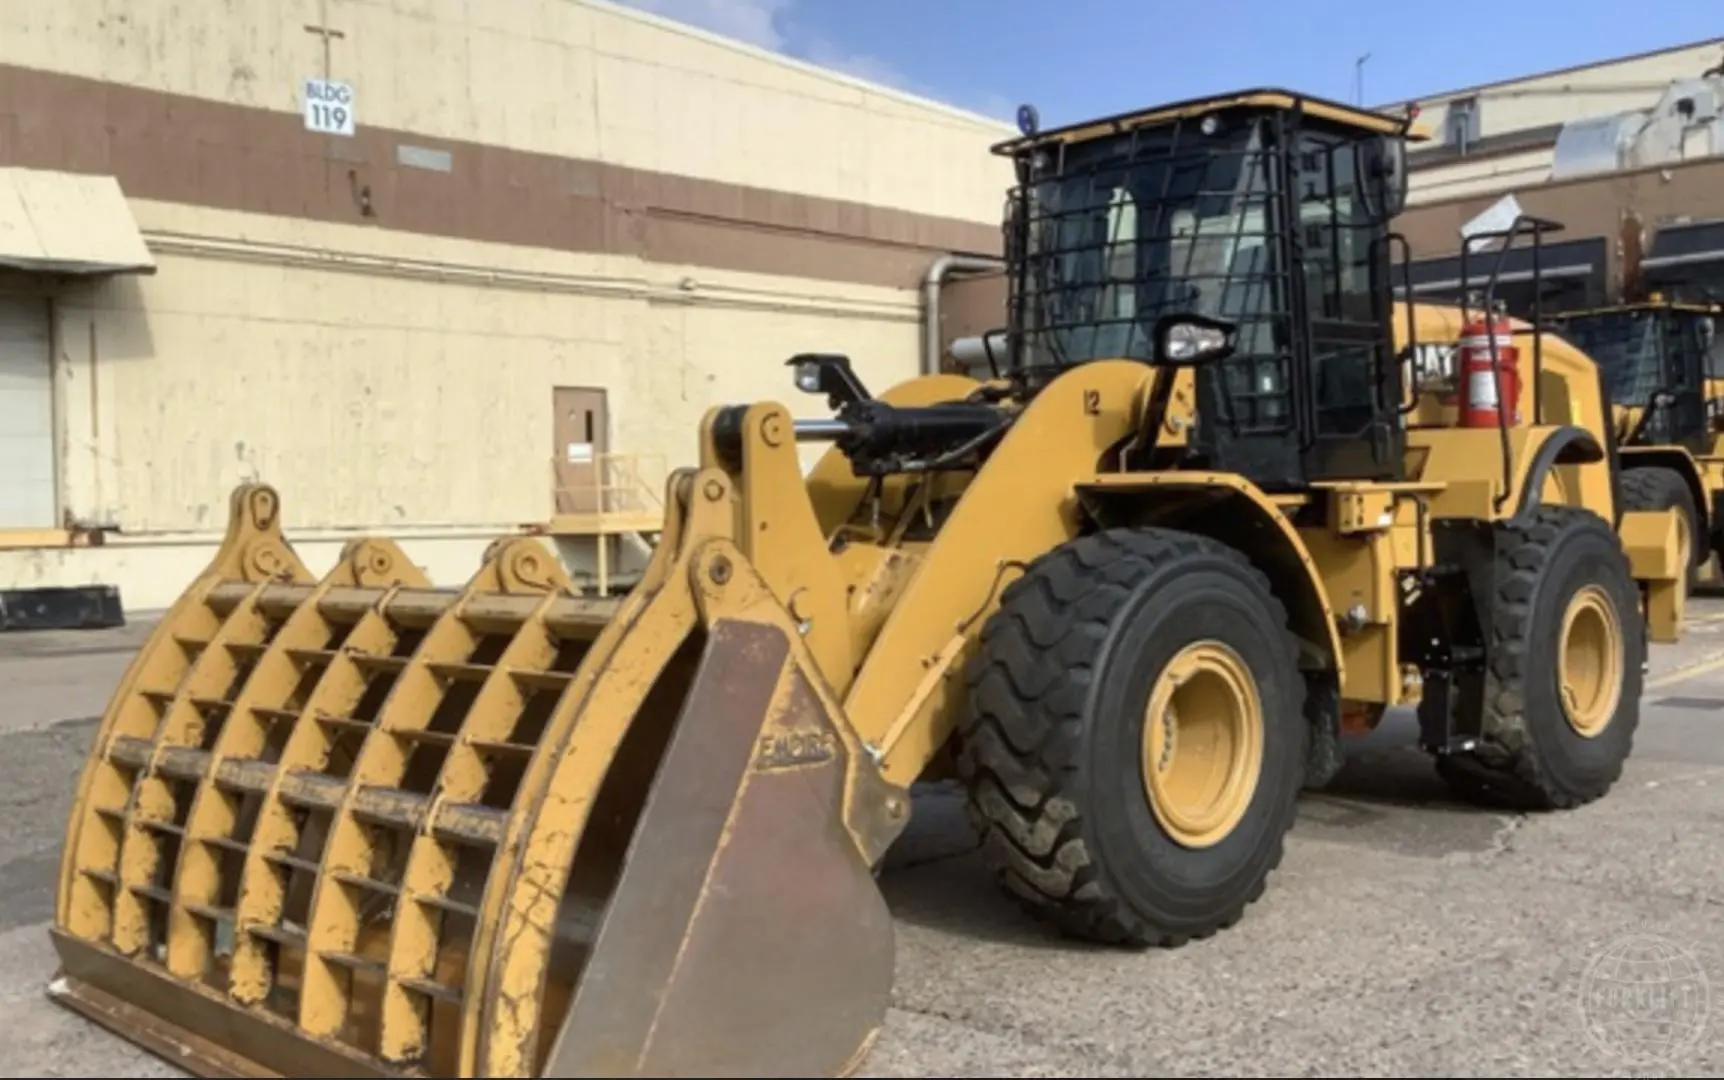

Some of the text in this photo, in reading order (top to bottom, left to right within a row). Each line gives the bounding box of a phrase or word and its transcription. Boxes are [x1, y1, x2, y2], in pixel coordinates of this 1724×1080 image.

[306, 82, 350, 105] BLDG
[312, 104, 347, 130] 119
[1083, 389, 1100, 416] 12
